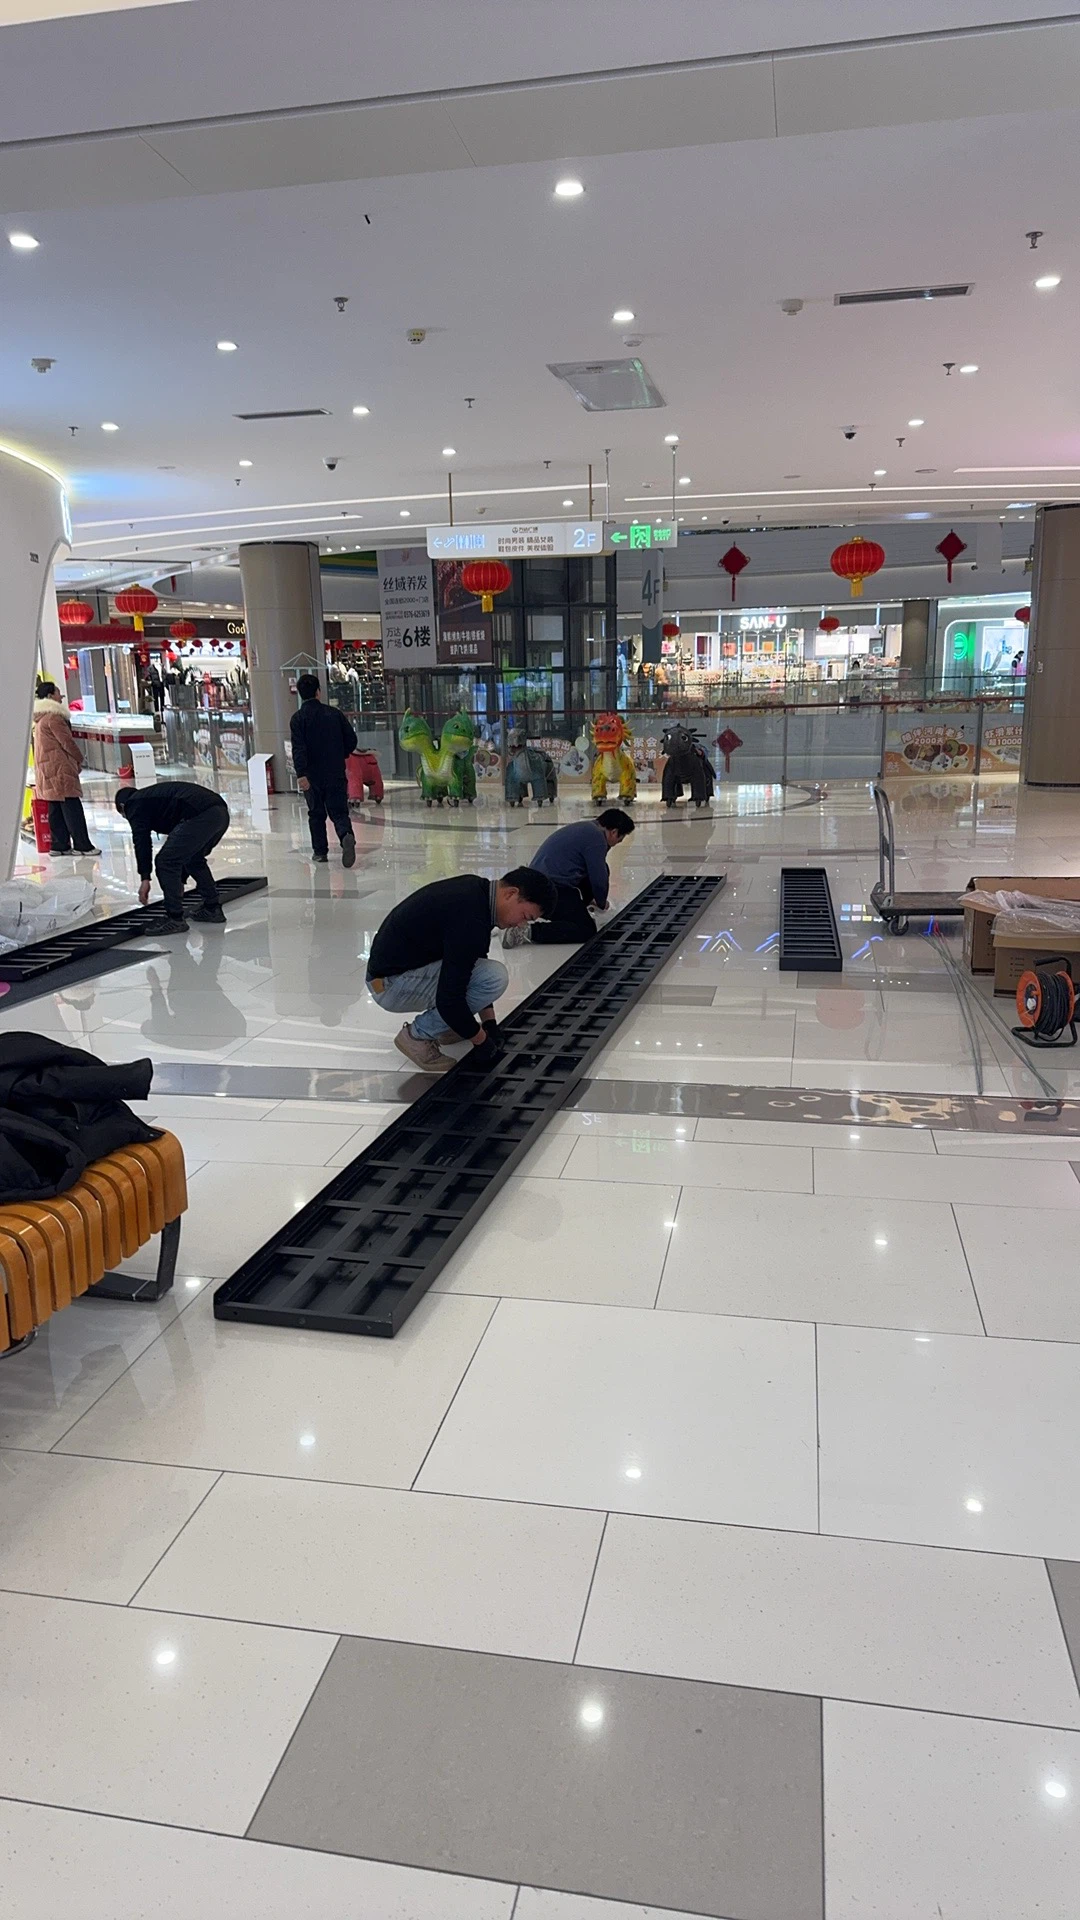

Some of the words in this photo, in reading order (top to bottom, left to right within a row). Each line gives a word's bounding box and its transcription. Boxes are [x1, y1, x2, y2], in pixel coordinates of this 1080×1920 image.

[497, 537, 525, 545] 时尚男装
[573, 528, 596, 548] 2F
[383, 574, 428, 593] 丝域养发
[642, 569, 660, 606] 4F
[740, 614, 787, 630] SANFU
[386, 626, 401, 638] 万达
[402, 625, 431, 648] 6楼
[386, 639, 402, 649] 广场
[914, 737, 944, 745] 2000天
